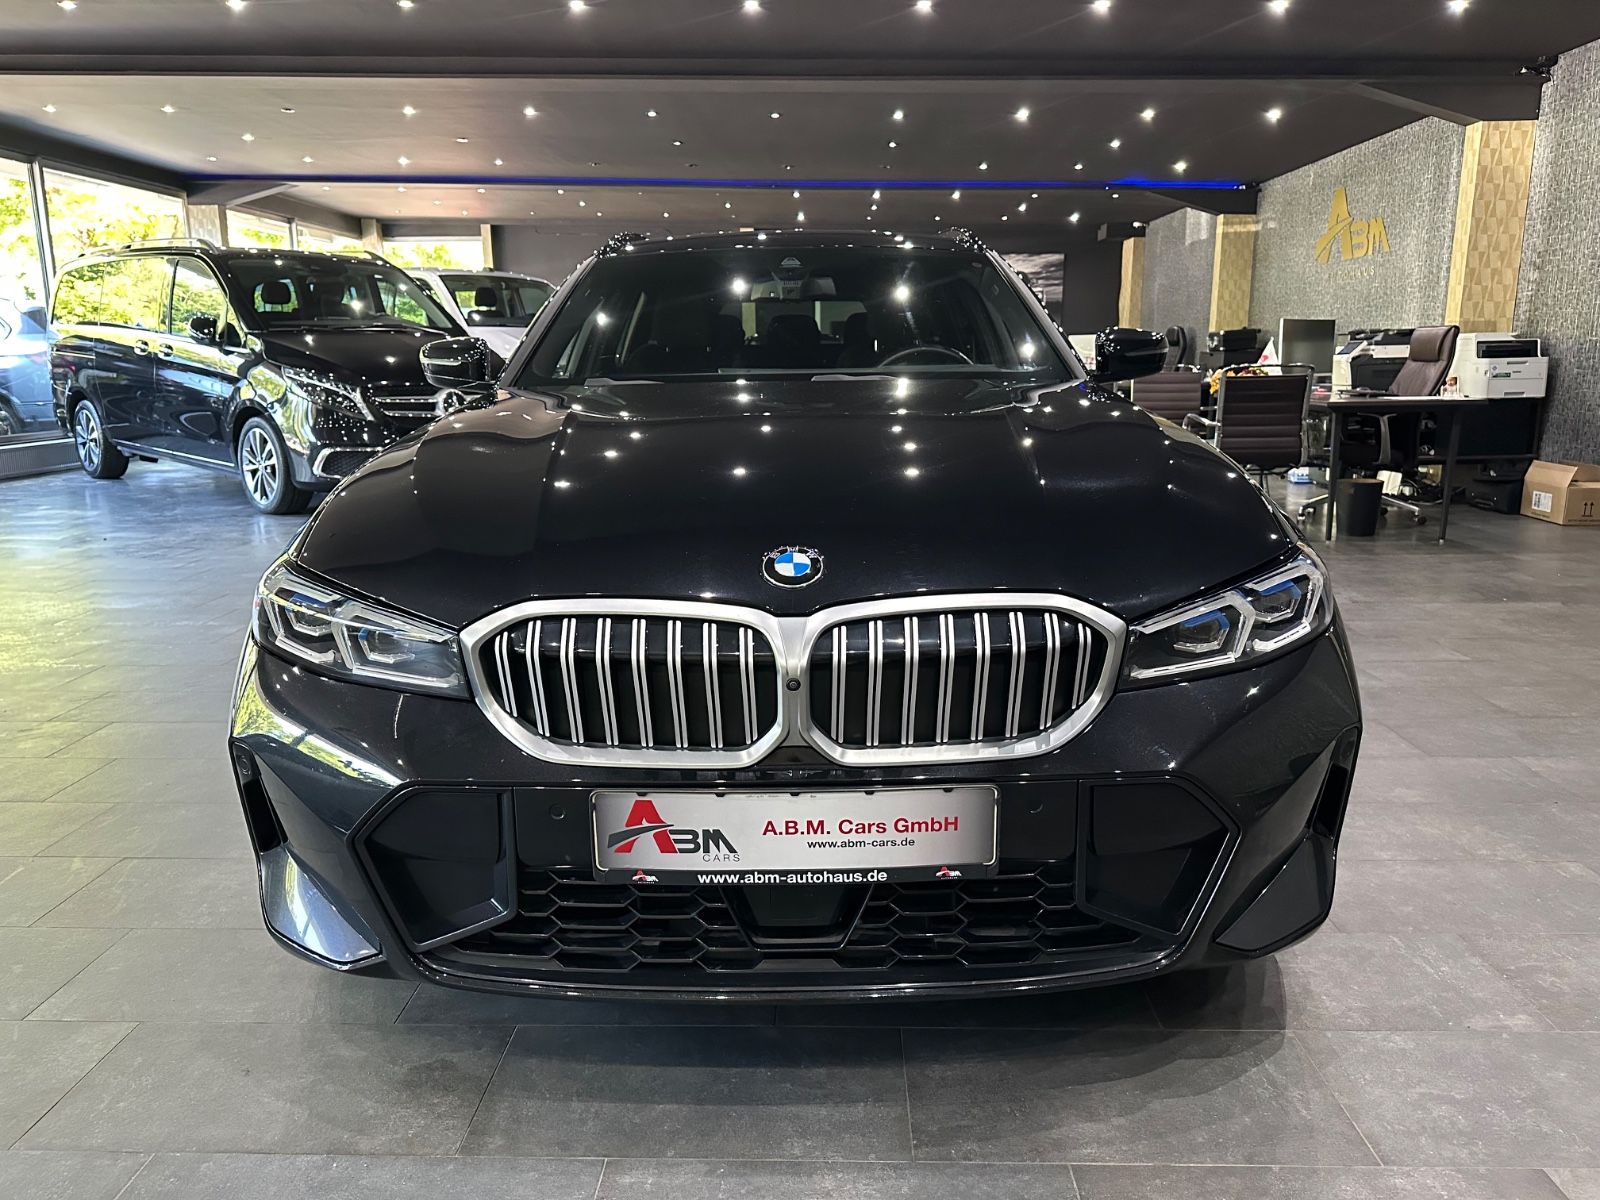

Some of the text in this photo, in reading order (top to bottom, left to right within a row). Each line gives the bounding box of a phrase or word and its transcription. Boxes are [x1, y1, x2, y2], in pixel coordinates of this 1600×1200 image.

[1315, 186, 1391, 266] ABM
[607, 799, 738, 854] ABM
[762, 816, 959, 836] A.B.M. Cars GmbH
[807, 837, 916, 849] www.abm-cars.de
[702, 853, 740, 863] CARS
[697, 869, 888, 884] www.abm-autohaus.de
